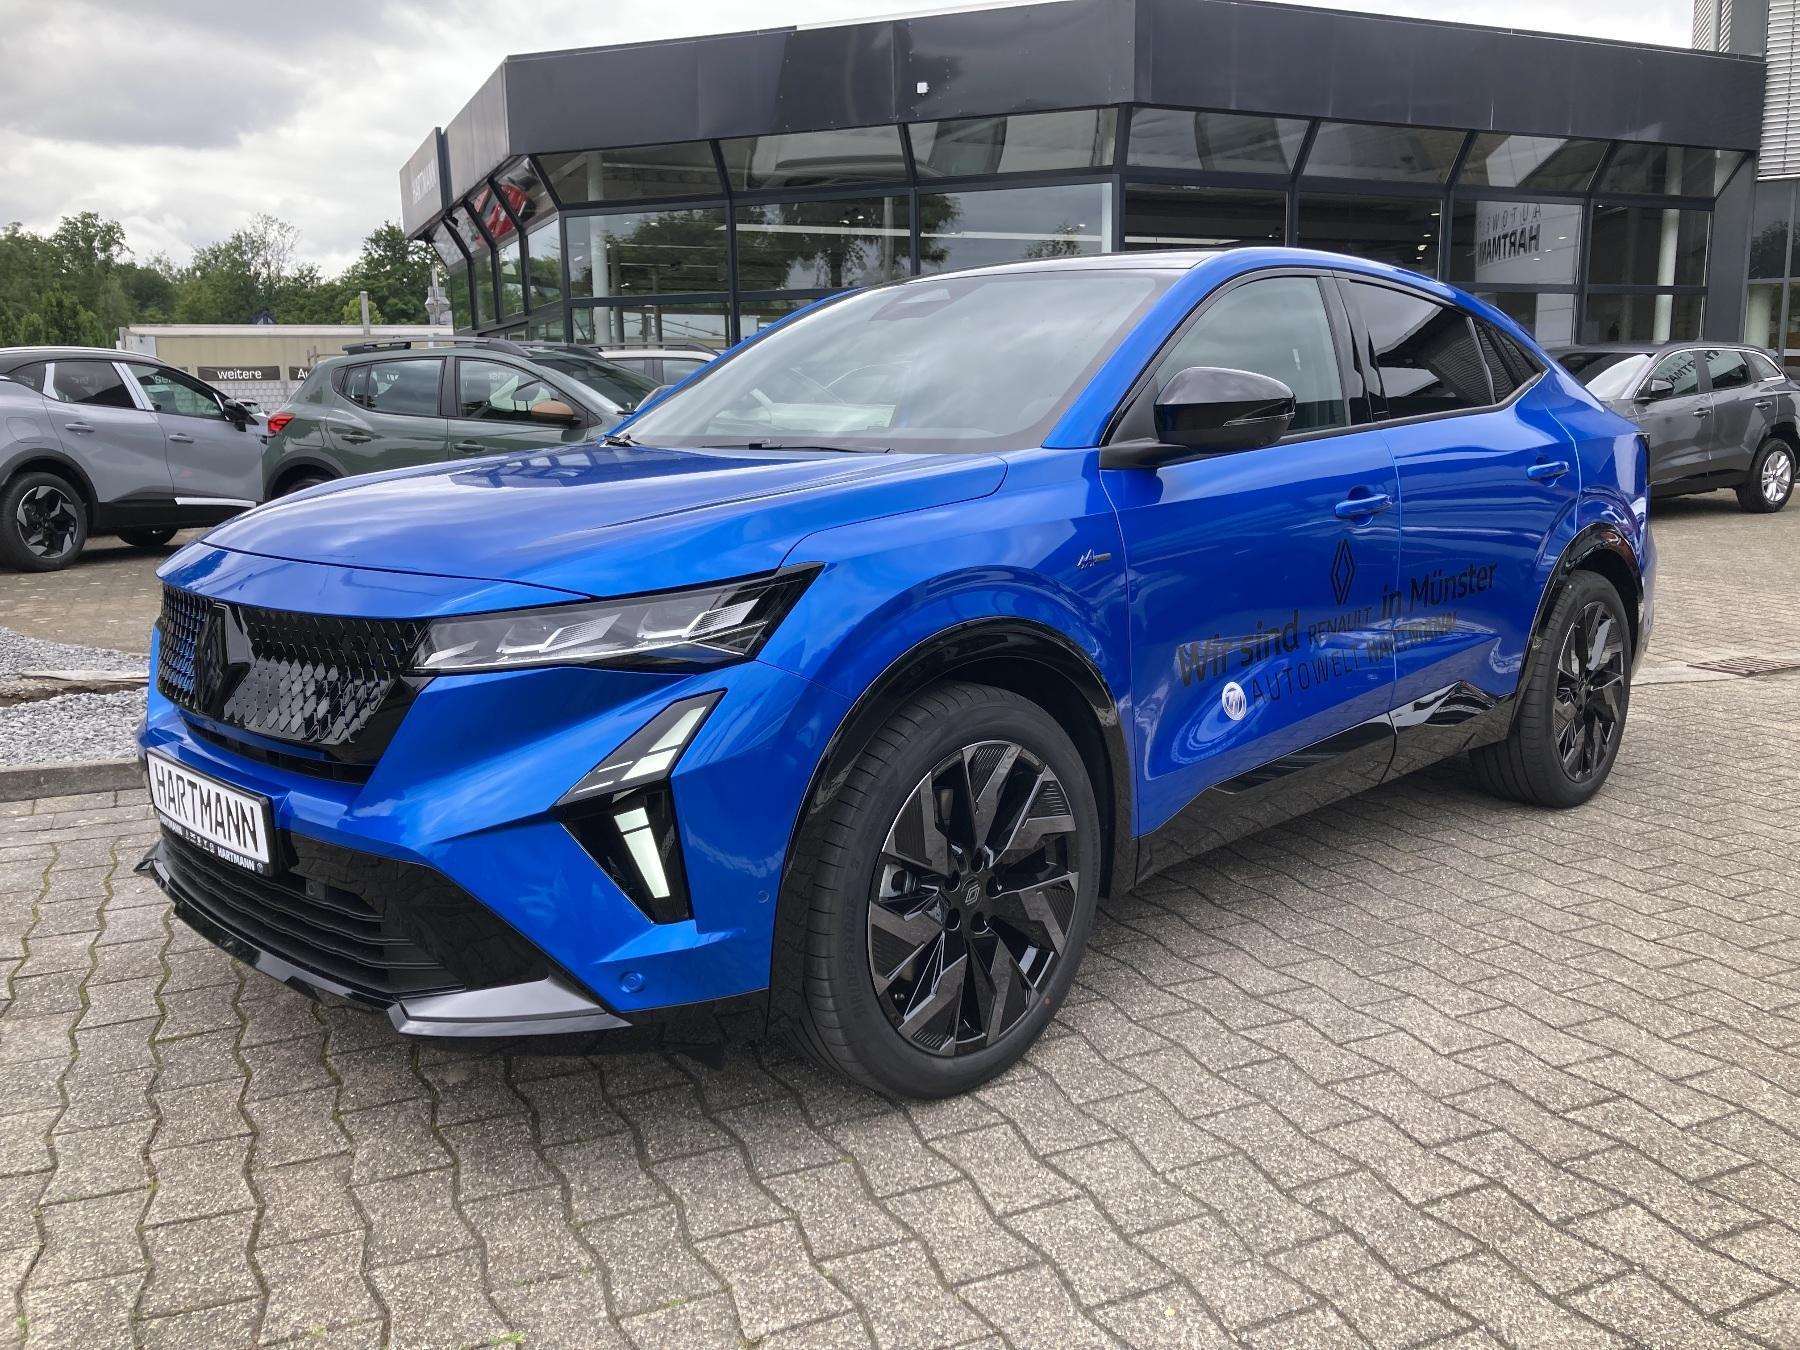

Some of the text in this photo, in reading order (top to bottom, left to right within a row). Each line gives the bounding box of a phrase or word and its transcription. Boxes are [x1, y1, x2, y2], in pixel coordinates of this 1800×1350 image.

[216, 368, 263, 380] weitere
[1177, 562, 1497, 687] Wir sind RENAULT in Münster
[1252, 642, 1360, 707] AUTOWELT
[153, 762, 259, 853] HARTMANN
